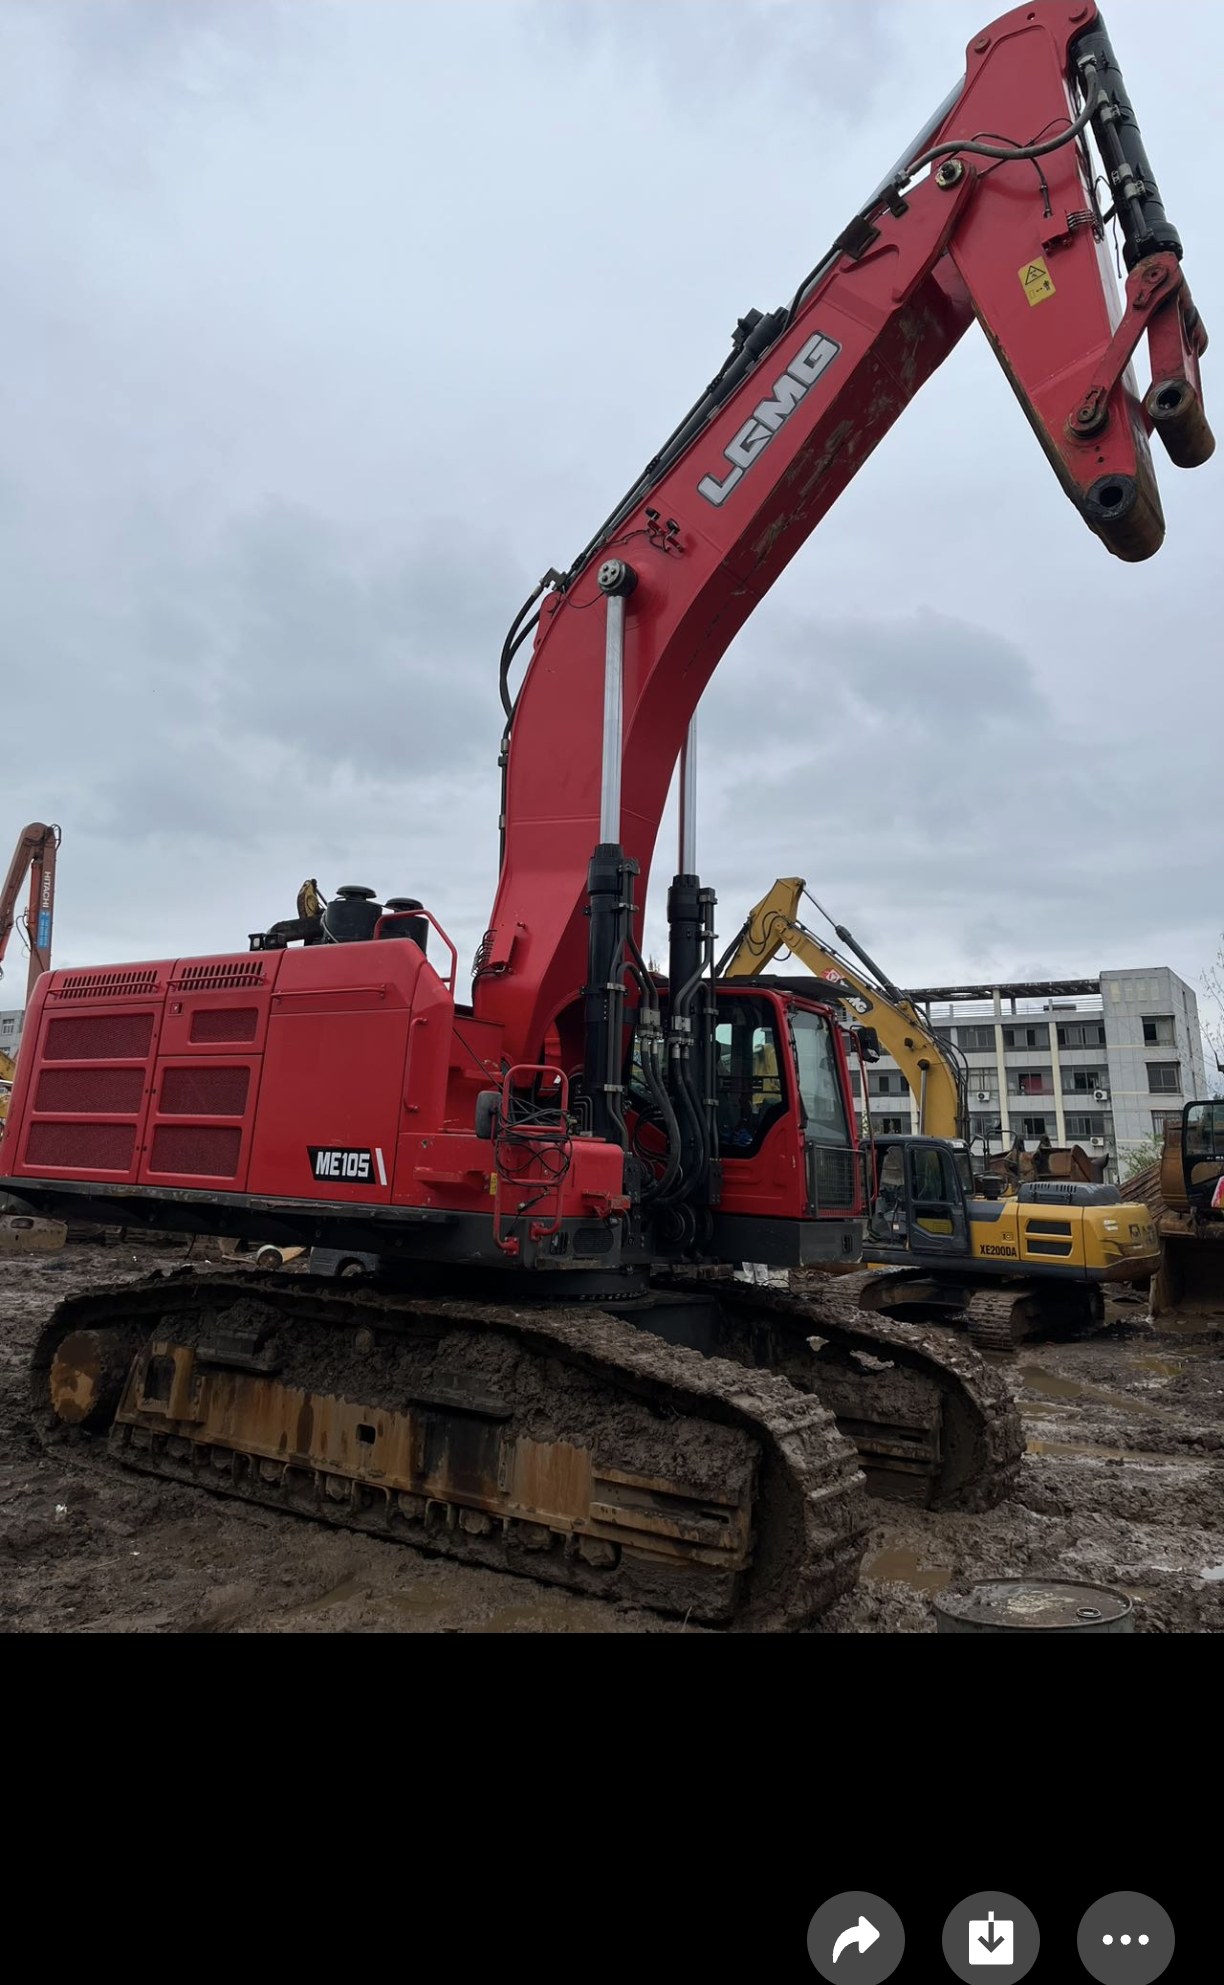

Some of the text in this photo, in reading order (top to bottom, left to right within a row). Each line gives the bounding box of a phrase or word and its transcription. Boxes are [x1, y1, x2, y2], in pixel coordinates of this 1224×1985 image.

[697, 330, 842, 507] LGMG
[42, 871, 51, 908] HITACHI
[315, 1151, 370, 1178] ME105
[980, 1244, 1018, 1257] XE200DA
